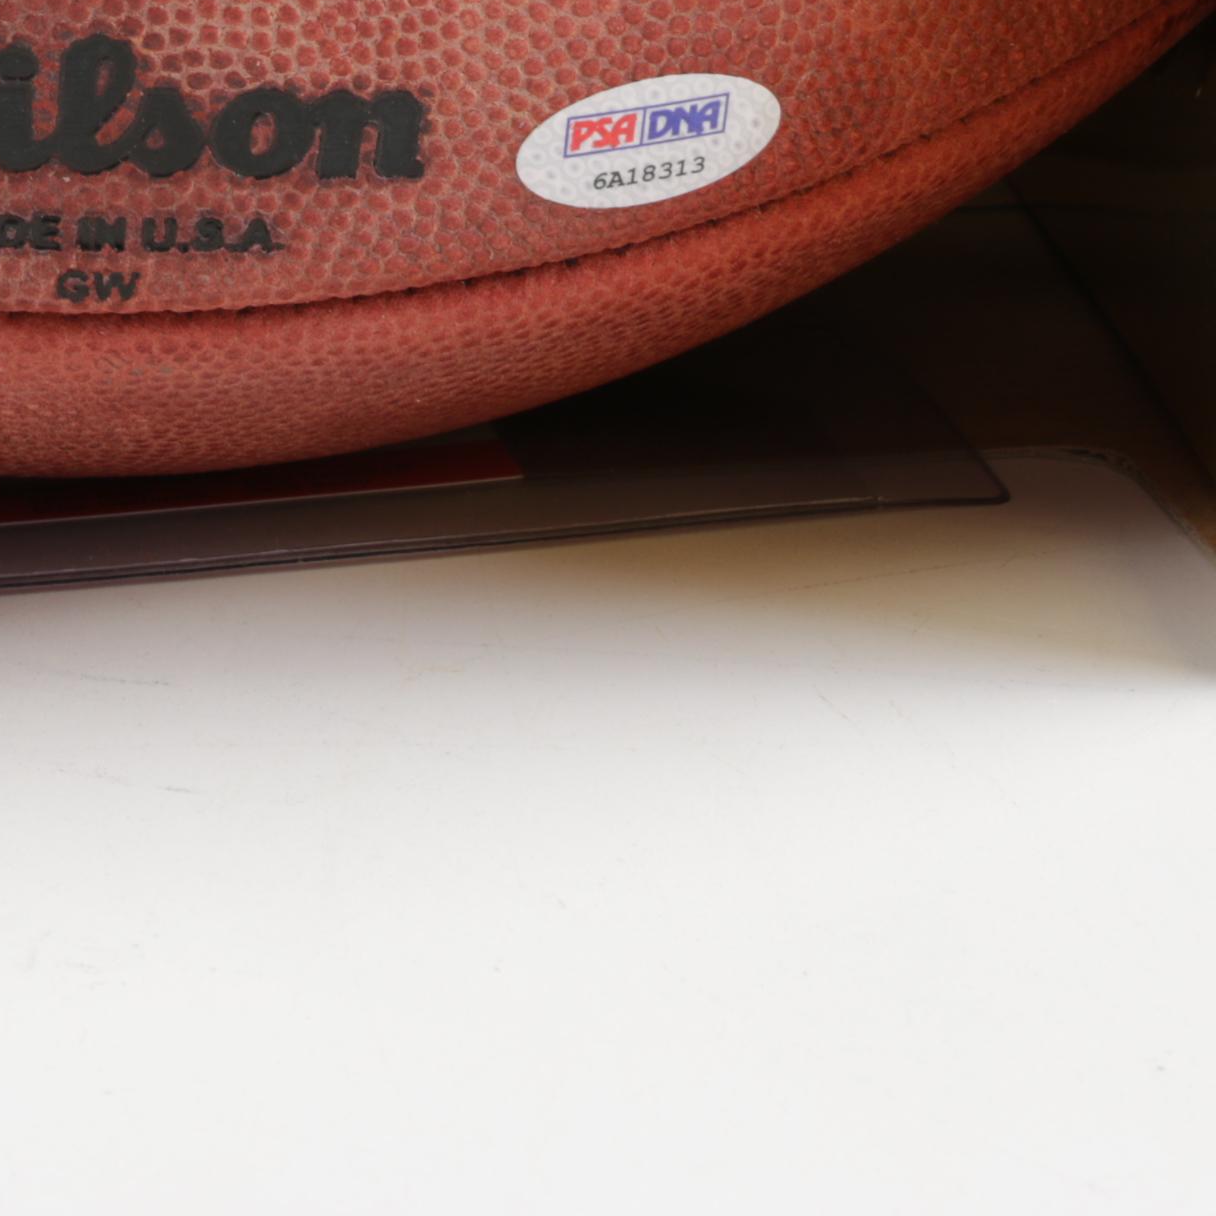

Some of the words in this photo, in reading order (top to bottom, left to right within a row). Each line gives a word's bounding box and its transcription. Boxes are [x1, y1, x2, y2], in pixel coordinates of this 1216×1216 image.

[568, 112, 638, 153] PSA
[646, 98, 722, 141] DNA
[592, 156, 706, 190] 6A18313
[77, 215, 127, 253] IN
[56, 268, 141, 303] GW
